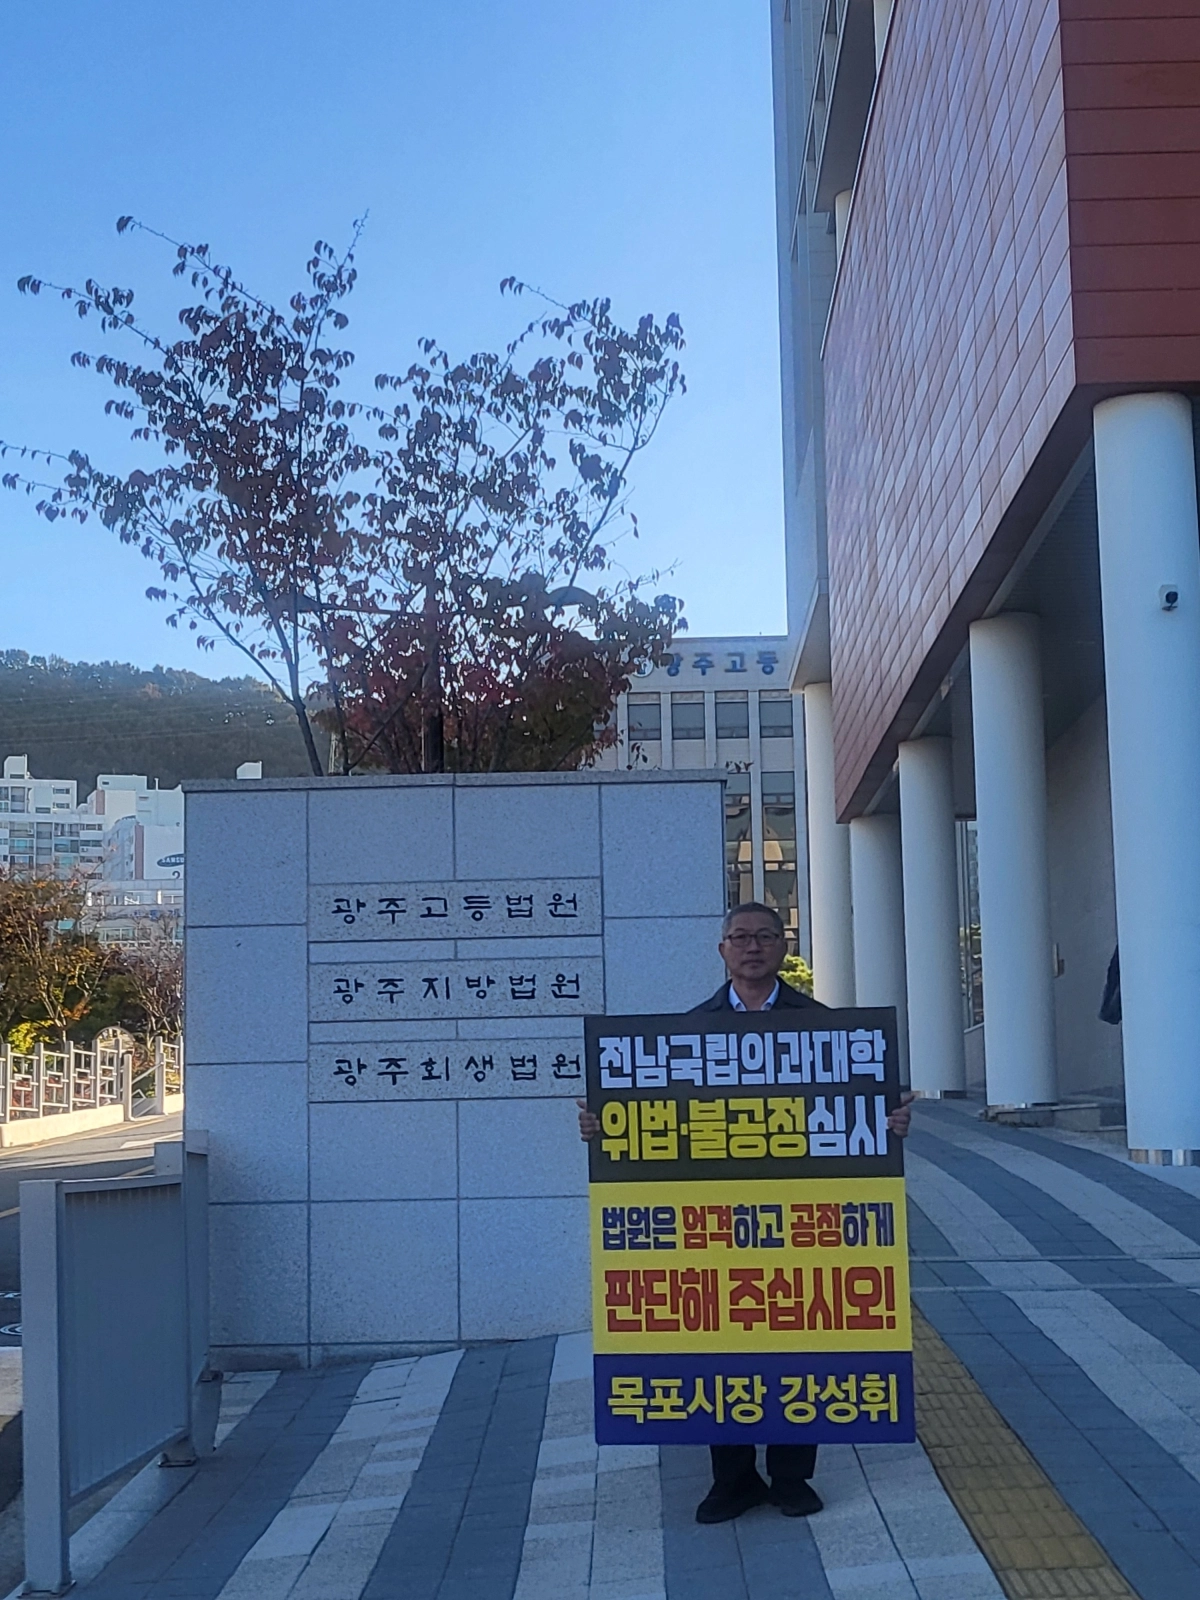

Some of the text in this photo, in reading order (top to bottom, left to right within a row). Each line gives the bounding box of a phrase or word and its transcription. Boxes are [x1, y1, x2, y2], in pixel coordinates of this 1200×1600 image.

[331, 893, 579, 924] 광주고등법원
[332, 973, 580, 1004] 광주지방법원
[332, 1053, 582, 1086] 광주회생법원
[599, 1028, 886, 1089] 전남국립의과대학
[602, 1202, 895, 1250] 법원은 엄격하고 공정하게
[604, 1266, 896, 1332] 판단해 주십시오!
[607, 1373, 898, 1423] 목포시장 강성휘
